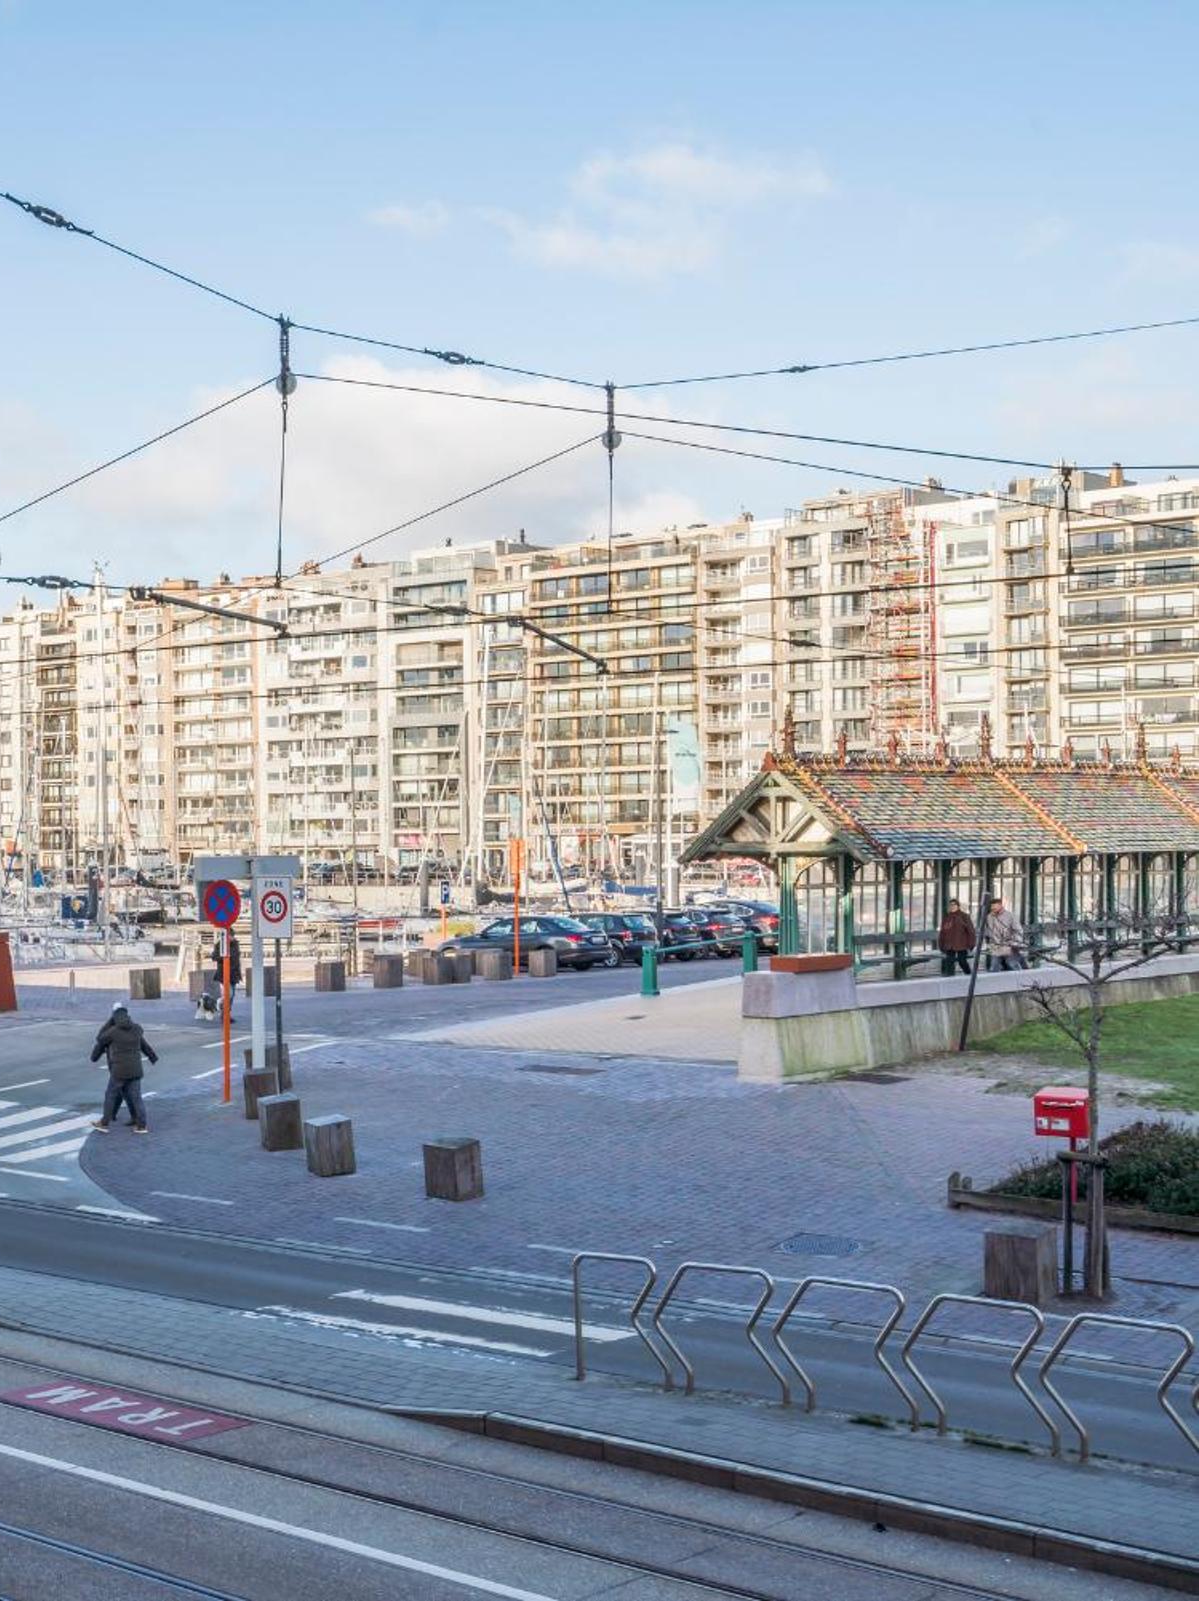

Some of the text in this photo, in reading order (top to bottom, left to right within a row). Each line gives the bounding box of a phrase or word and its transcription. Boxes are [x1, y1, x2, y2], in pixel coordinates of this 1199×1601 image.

[264, 880, 284, 888] ZONE
[442, 885, 449, 902] P
[266, 900, 282, 914] 30
[25, 1386, 214, 1436] TRAM
